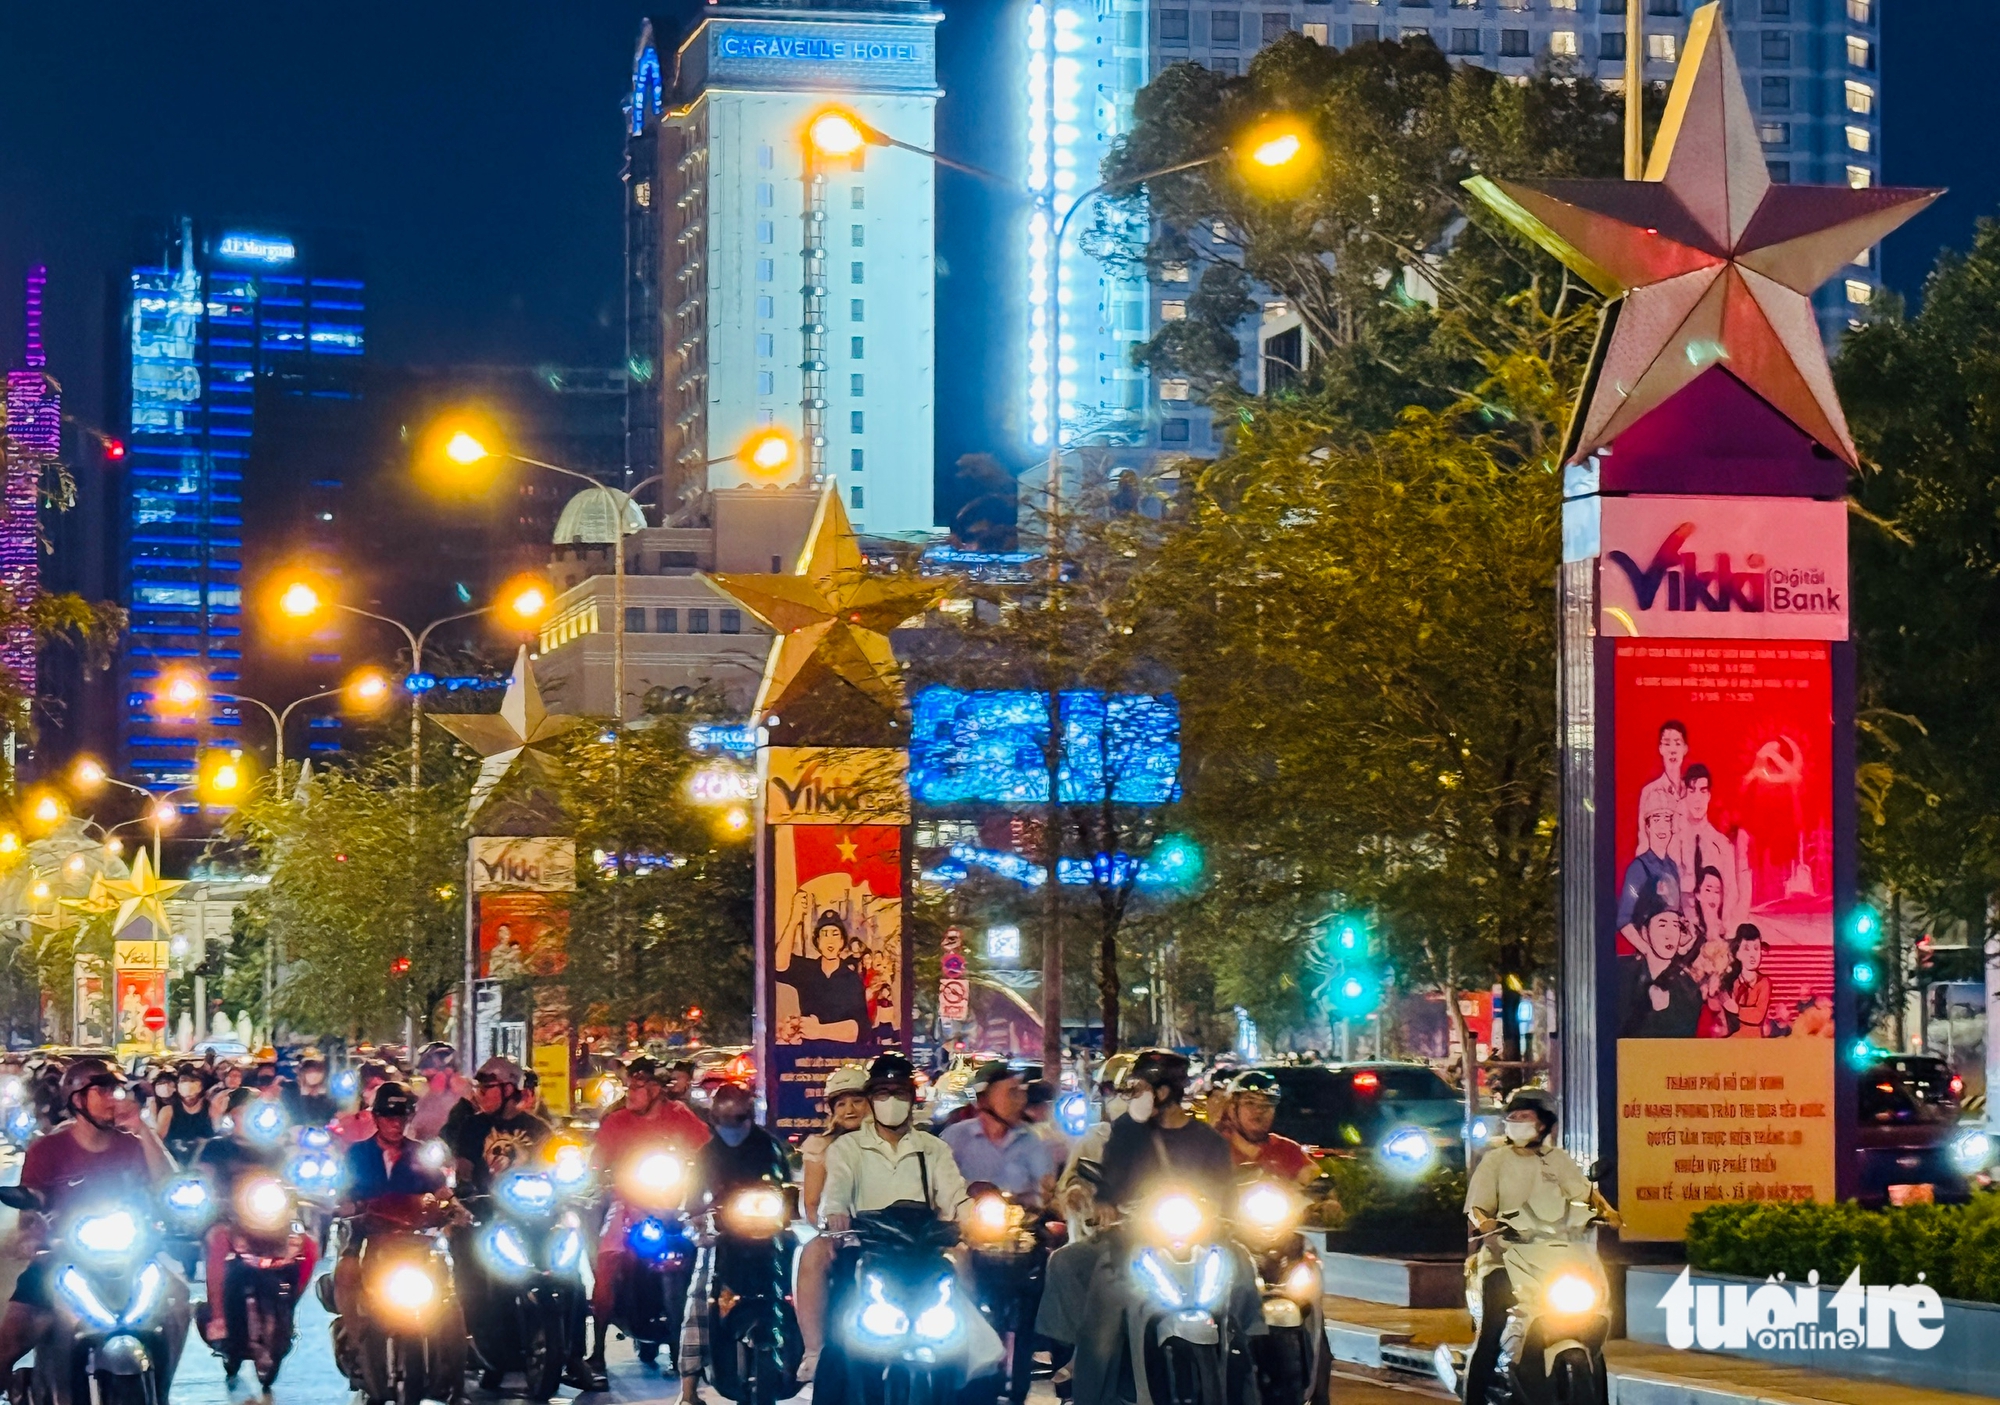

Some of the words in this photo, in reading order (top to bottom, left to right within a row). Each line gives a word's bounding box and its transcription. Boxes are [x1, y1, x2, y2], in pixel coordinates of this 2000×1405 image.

[725, 38, 846, 58] CARAVELLE
[854, 42, 922, 61] HOTEL
[1608, 521, 1765, 612] Vikki
[1773, 568, 1825, 587] Digital
[1773, 587, 1841, 612] Bank
